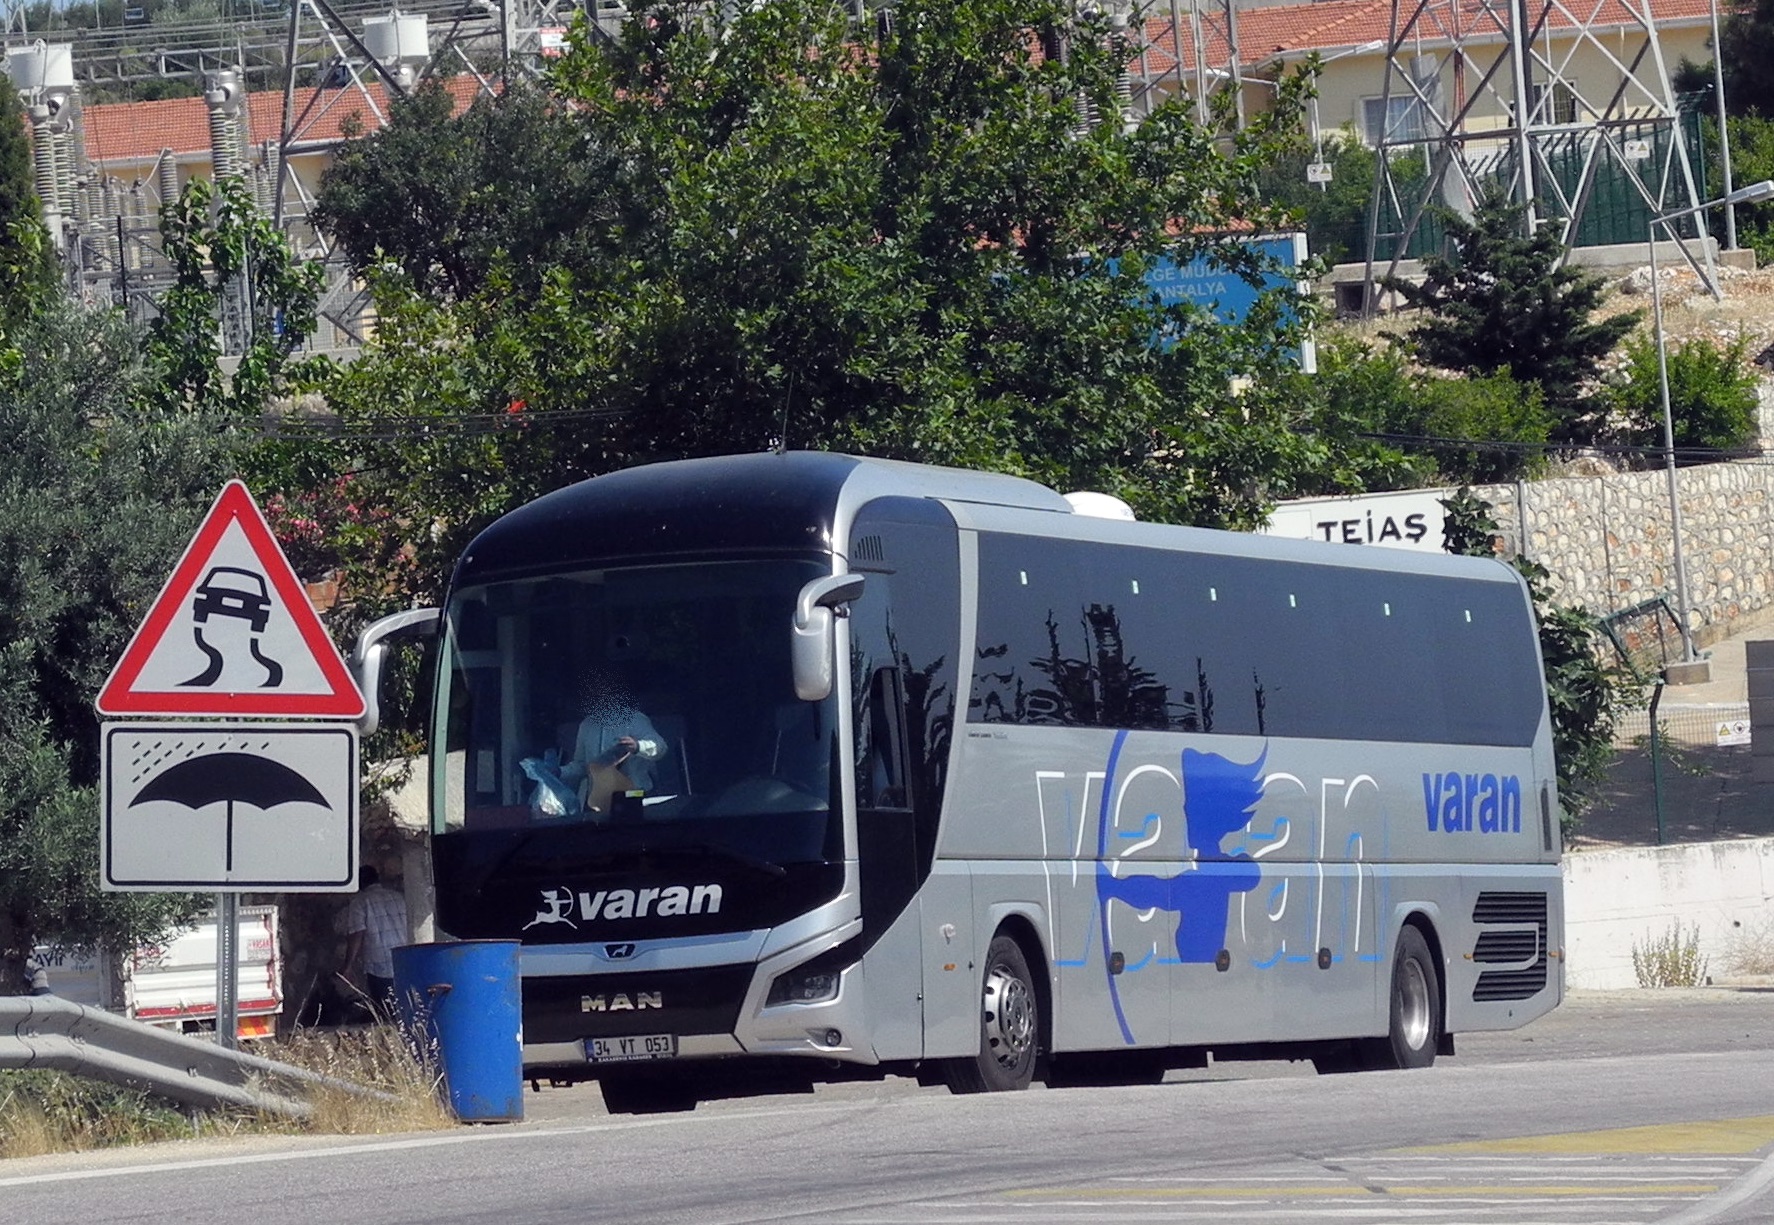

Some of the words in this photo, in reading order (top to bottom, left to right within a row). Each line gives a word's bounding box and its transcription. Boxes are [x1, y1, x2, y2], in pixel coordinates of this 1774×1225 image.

[1156, 281, 1227, 299] ANTALYA
[1316, 509, 1428, 545] TEİAŞ
[1422, 771, 1521, 834] varan
[578, 883, 723, 921] varan
[581, 991, 663, 1013] MAN
[594, 1040, 610, 1056] 34
[619, 1038, 635, 1054] VT
[645, 1036, 670, 1053] 053
